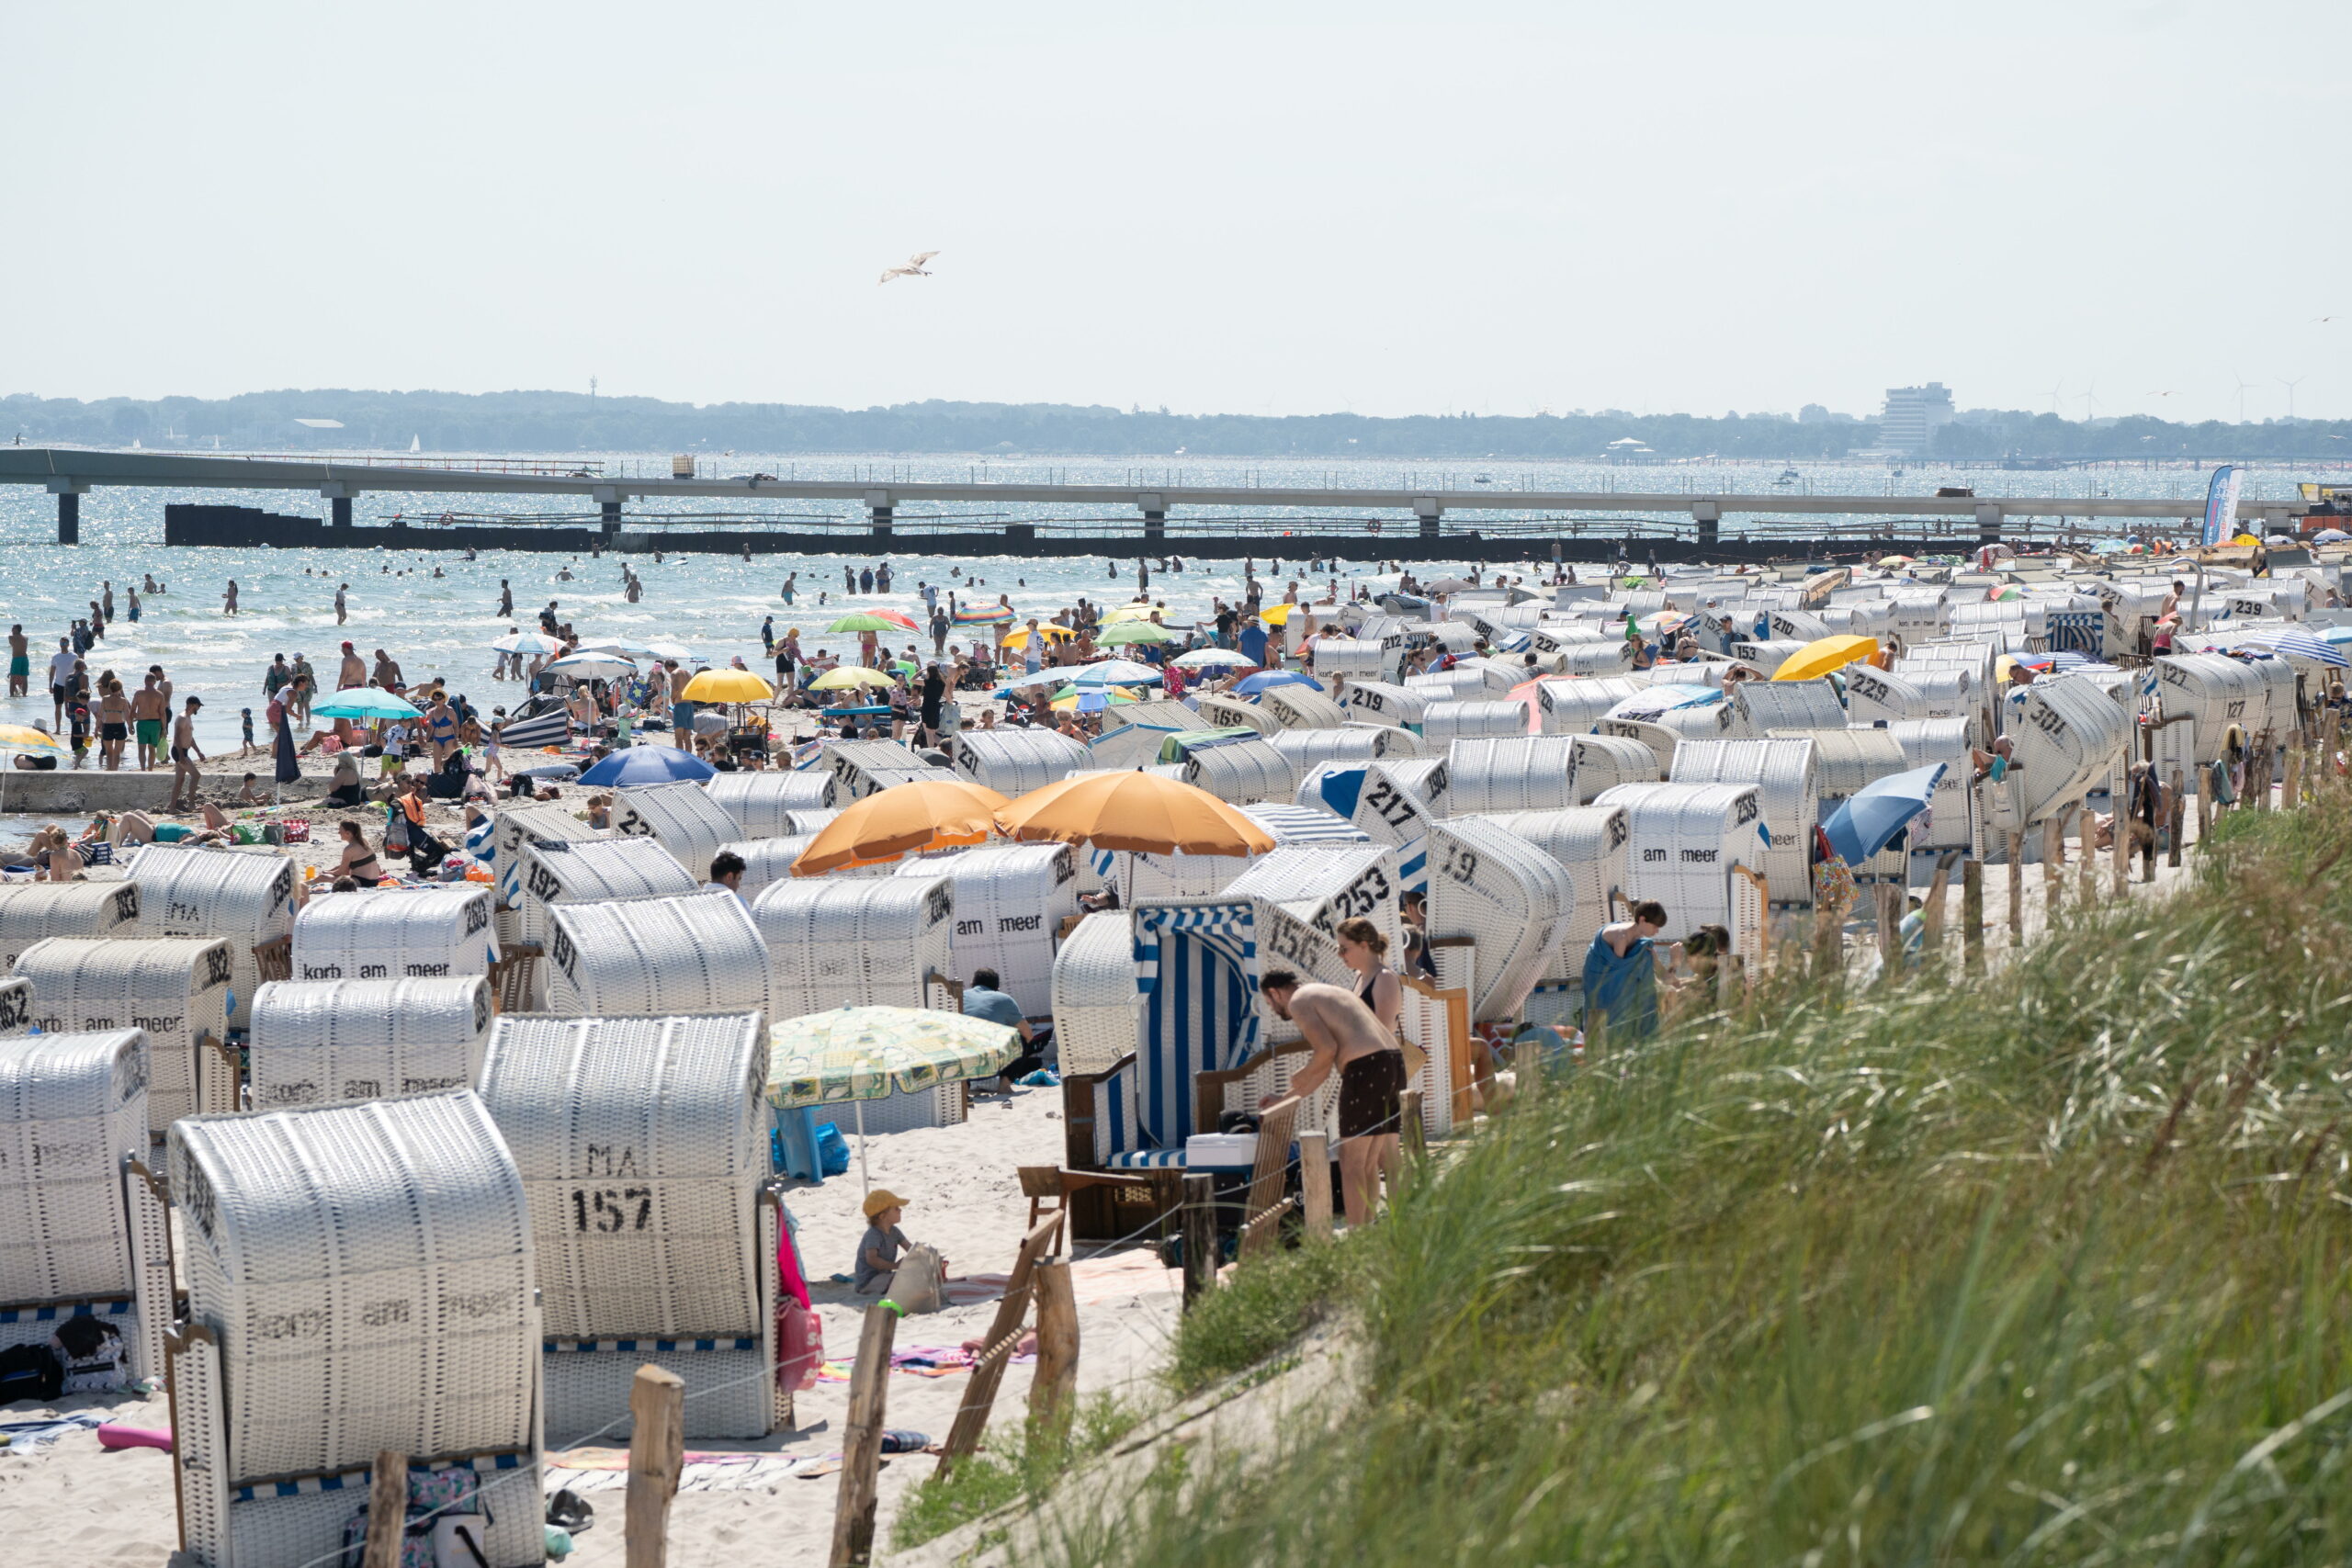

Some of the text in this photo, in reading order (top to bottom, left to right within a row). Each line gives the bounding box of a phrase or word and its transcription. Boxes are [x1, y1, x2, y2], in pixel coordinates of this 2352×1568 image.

[2235, 600, 2262, 615] 239
[1772, 616, 1794, 636] 210
[1383, 635, 1401, 649] 212
[1738, 645, 1757, 660] 153
[2163, 663, 2188, 687] 127
[1850, 673, 1889, 704] 229
[1352, 687, 1383, 712] 219
[2227, 701, 2245, 718] 127
[958, 742, 979, 776] 231
[1366, 781, 1417, 826] 217
[1644, 849, 1719, 863] am meer
[1334, 865, 1390, 919] 253
[171, 904, 199, 921] MA
[464, 897, 488, 937] 260
[957, 914, 1044, 935] am meer
[304, 961, 450, 979] korb am meer
[85, 1016, 114, 1031] am
[133, 1015, 184, 1031] meer
[587, 1144, 637, 1177] MA
[571, 1187, 652, 1233] 157
